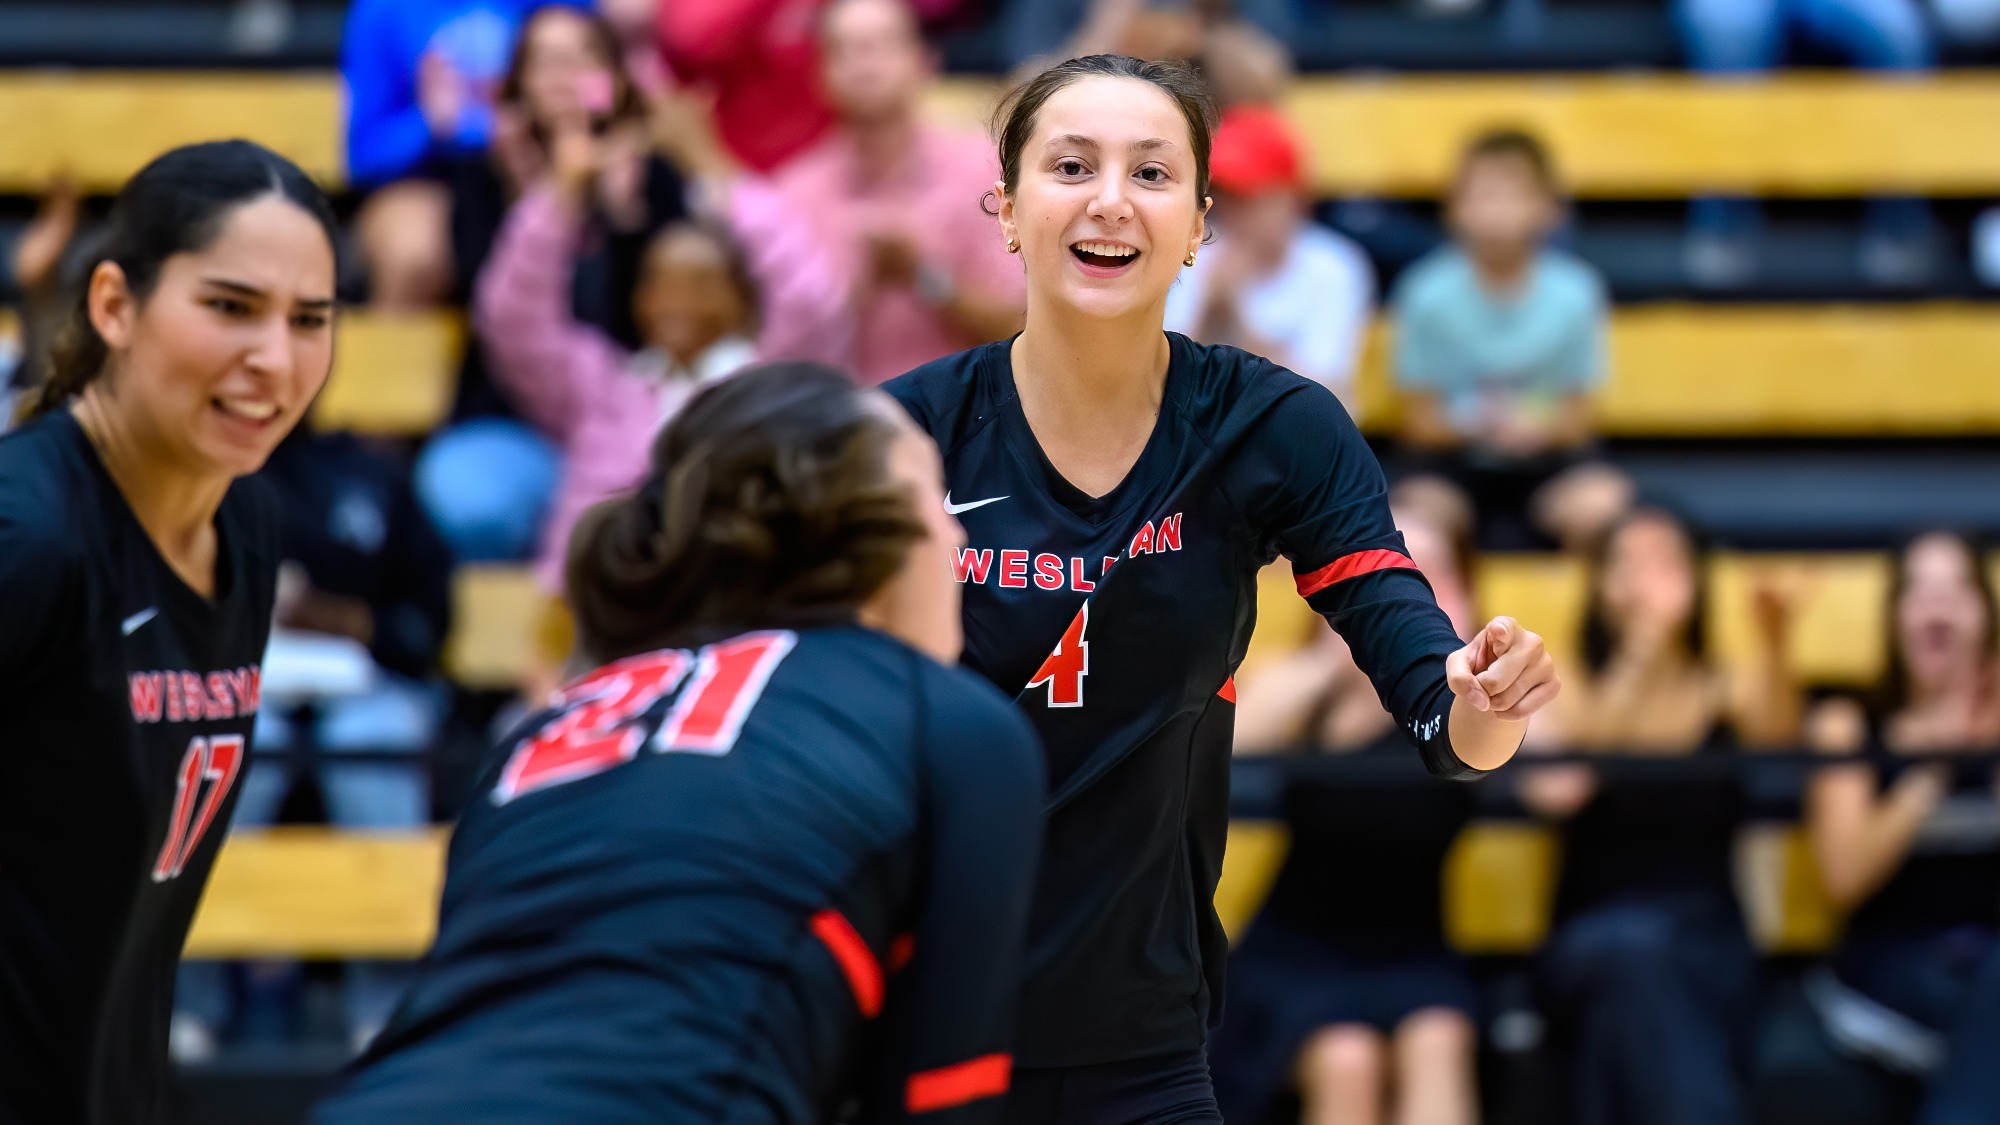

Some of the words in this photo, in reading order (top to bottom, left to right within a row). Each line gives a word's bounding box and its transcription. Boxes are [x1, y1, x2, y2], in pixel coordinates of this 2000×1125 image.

[950, 511, 1183, 593] WESLAN
[489, 628, 799, 807] 21
[1024, 598, 1089, 708] 4
[151, 733, 244, 882] 17
